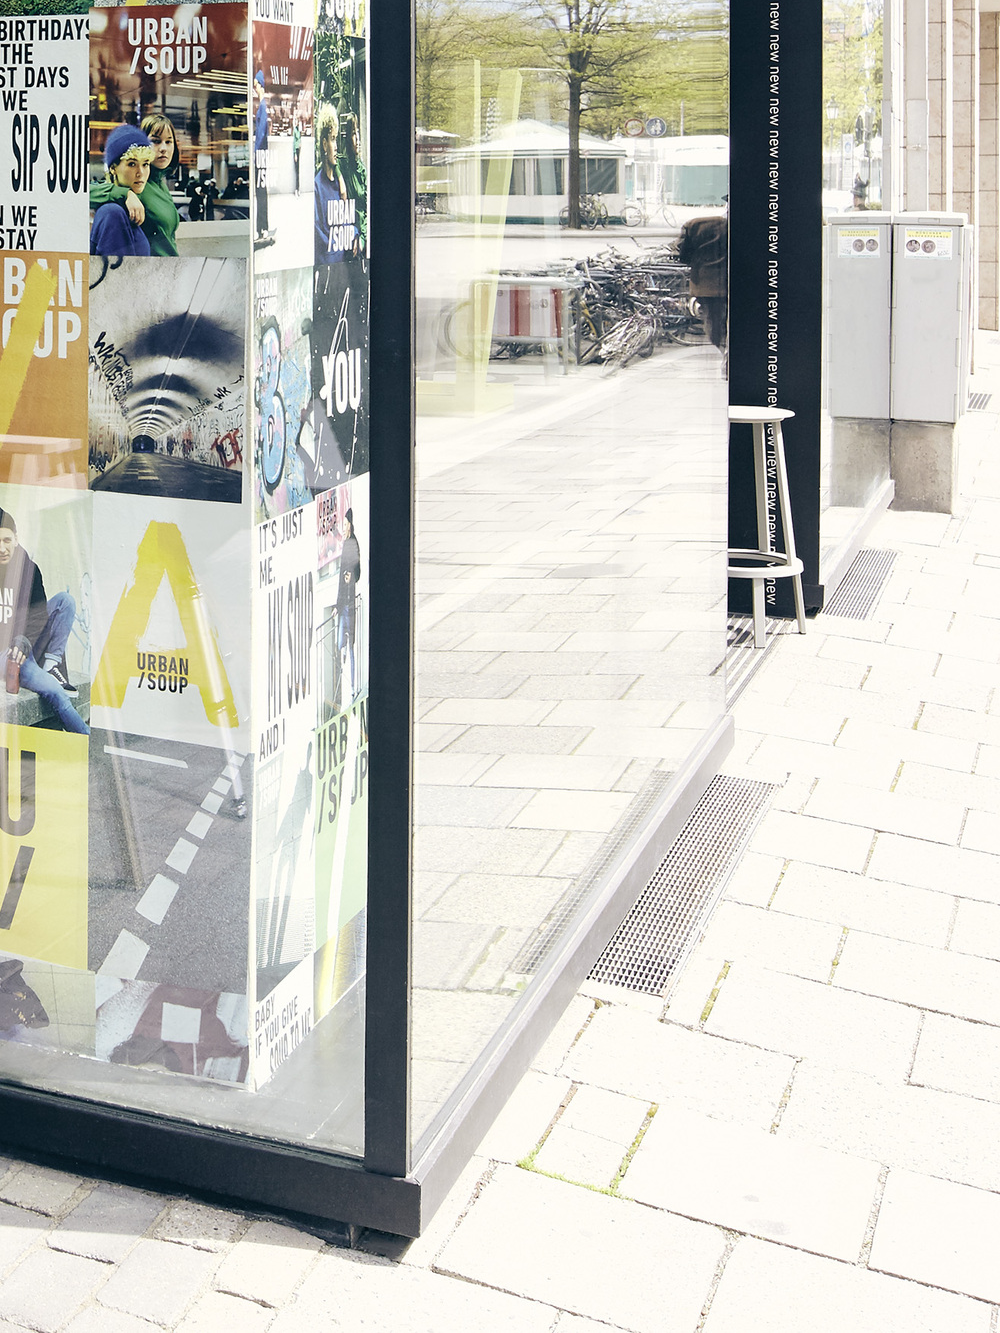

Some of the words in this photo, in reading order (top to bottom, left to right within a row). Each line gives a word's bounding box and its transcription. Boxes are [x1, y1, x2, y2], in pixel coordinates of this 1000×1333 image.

[128, 17, 208, 46] URBAN
[1, 44, 33, 64] THE
[130, 45, 207, 75] /SOUP
[25, 66, 69, 88] DAYS
[11, 113, 40, 193] SIP
[12, 205, 37, 226] WE
[327, 199, 355, 225] URBAN
[328, 224, 354, 252] /SOUP
[322, 348, 361, 417] YOU
[281, 508, 303, 545] JUST
[136, 652, 189, 676] URBAN
[137, 671, 188, 695] /SOUP
